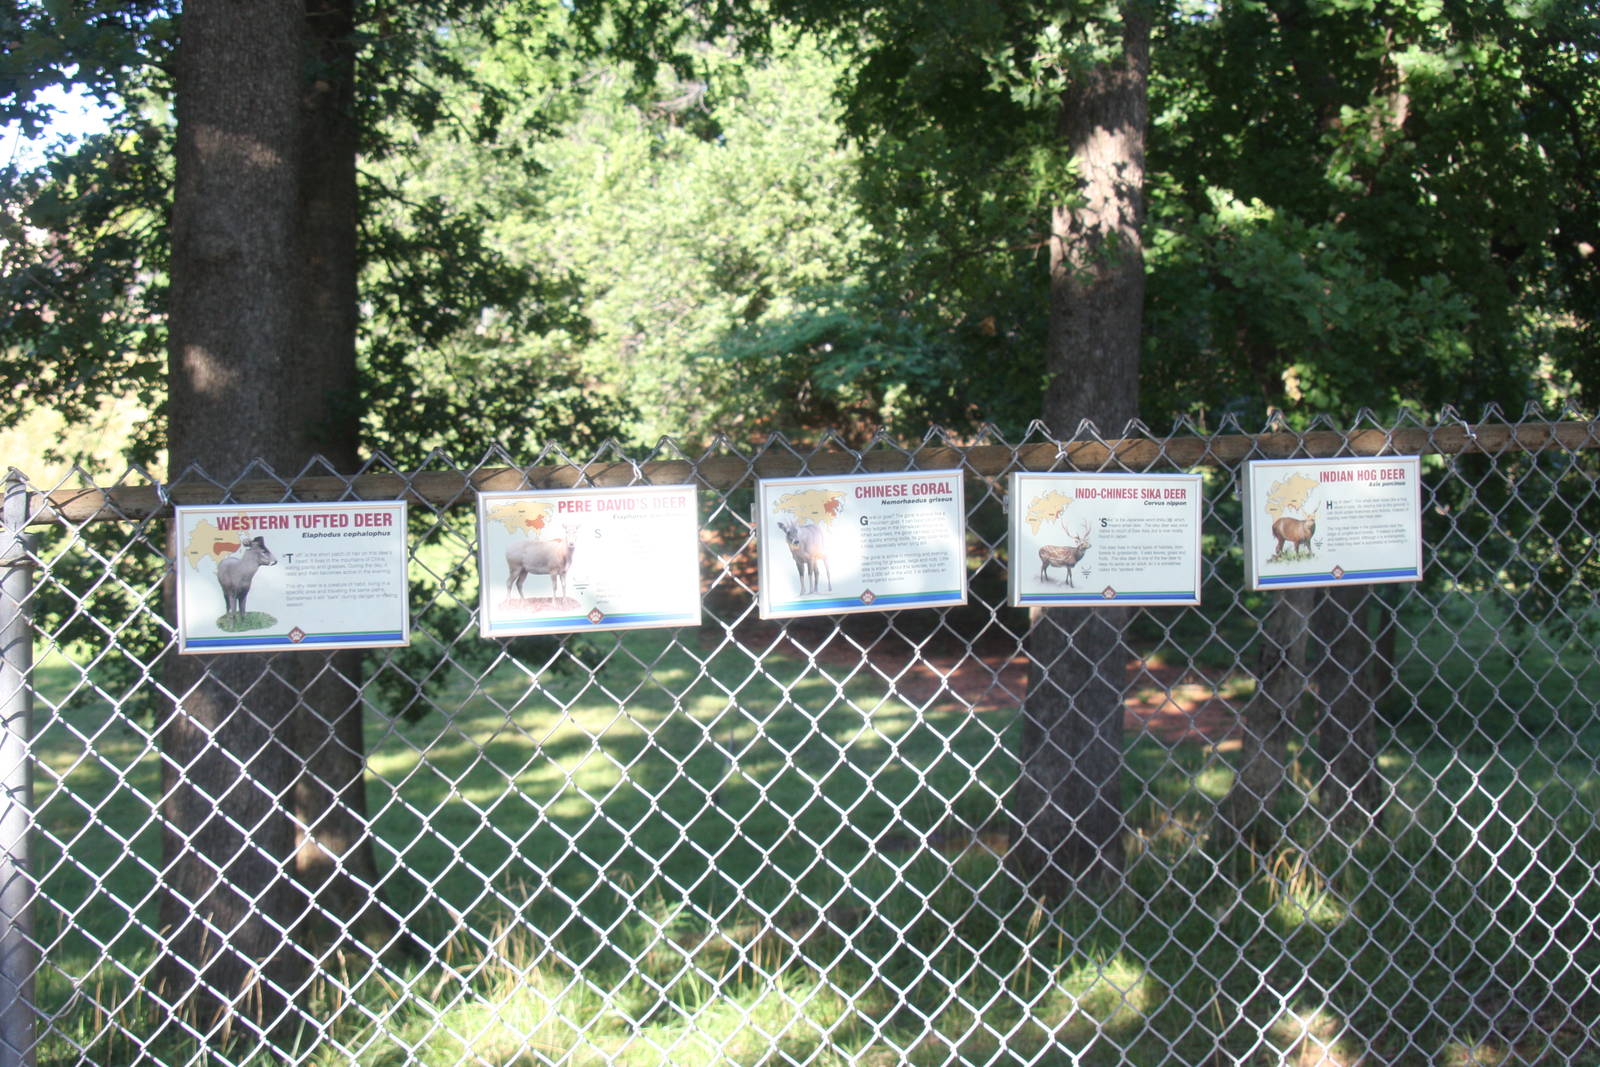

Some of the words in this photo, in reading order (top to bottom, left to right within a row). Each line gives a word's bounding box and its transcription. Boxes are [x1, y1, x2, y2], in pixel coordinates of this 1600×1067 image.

[1319, 471, 1354, 483] INDIAN
[1357, 470, 1377, 481] HOG
[1380, 468, 1405, 480] DEER
[855, 484, 908, 499] CHINESE
[912, 482, 953, 496] GORAL
[1075, 488, 1139, 500] INDO-CHINESE
[1141, 488, 1161, 499] SIKA
[1164, 488, 1187, 499] DEER
[557, 500, 592, 514] PERE
[597, 498, 648, 512] DAVID'S
[653, 496, 686, 510] DEER
[216, 516, 289, 531] WESTERN
[293, 513, 349, 529] TUFTED
[354, 512, 393, 527] DEER
